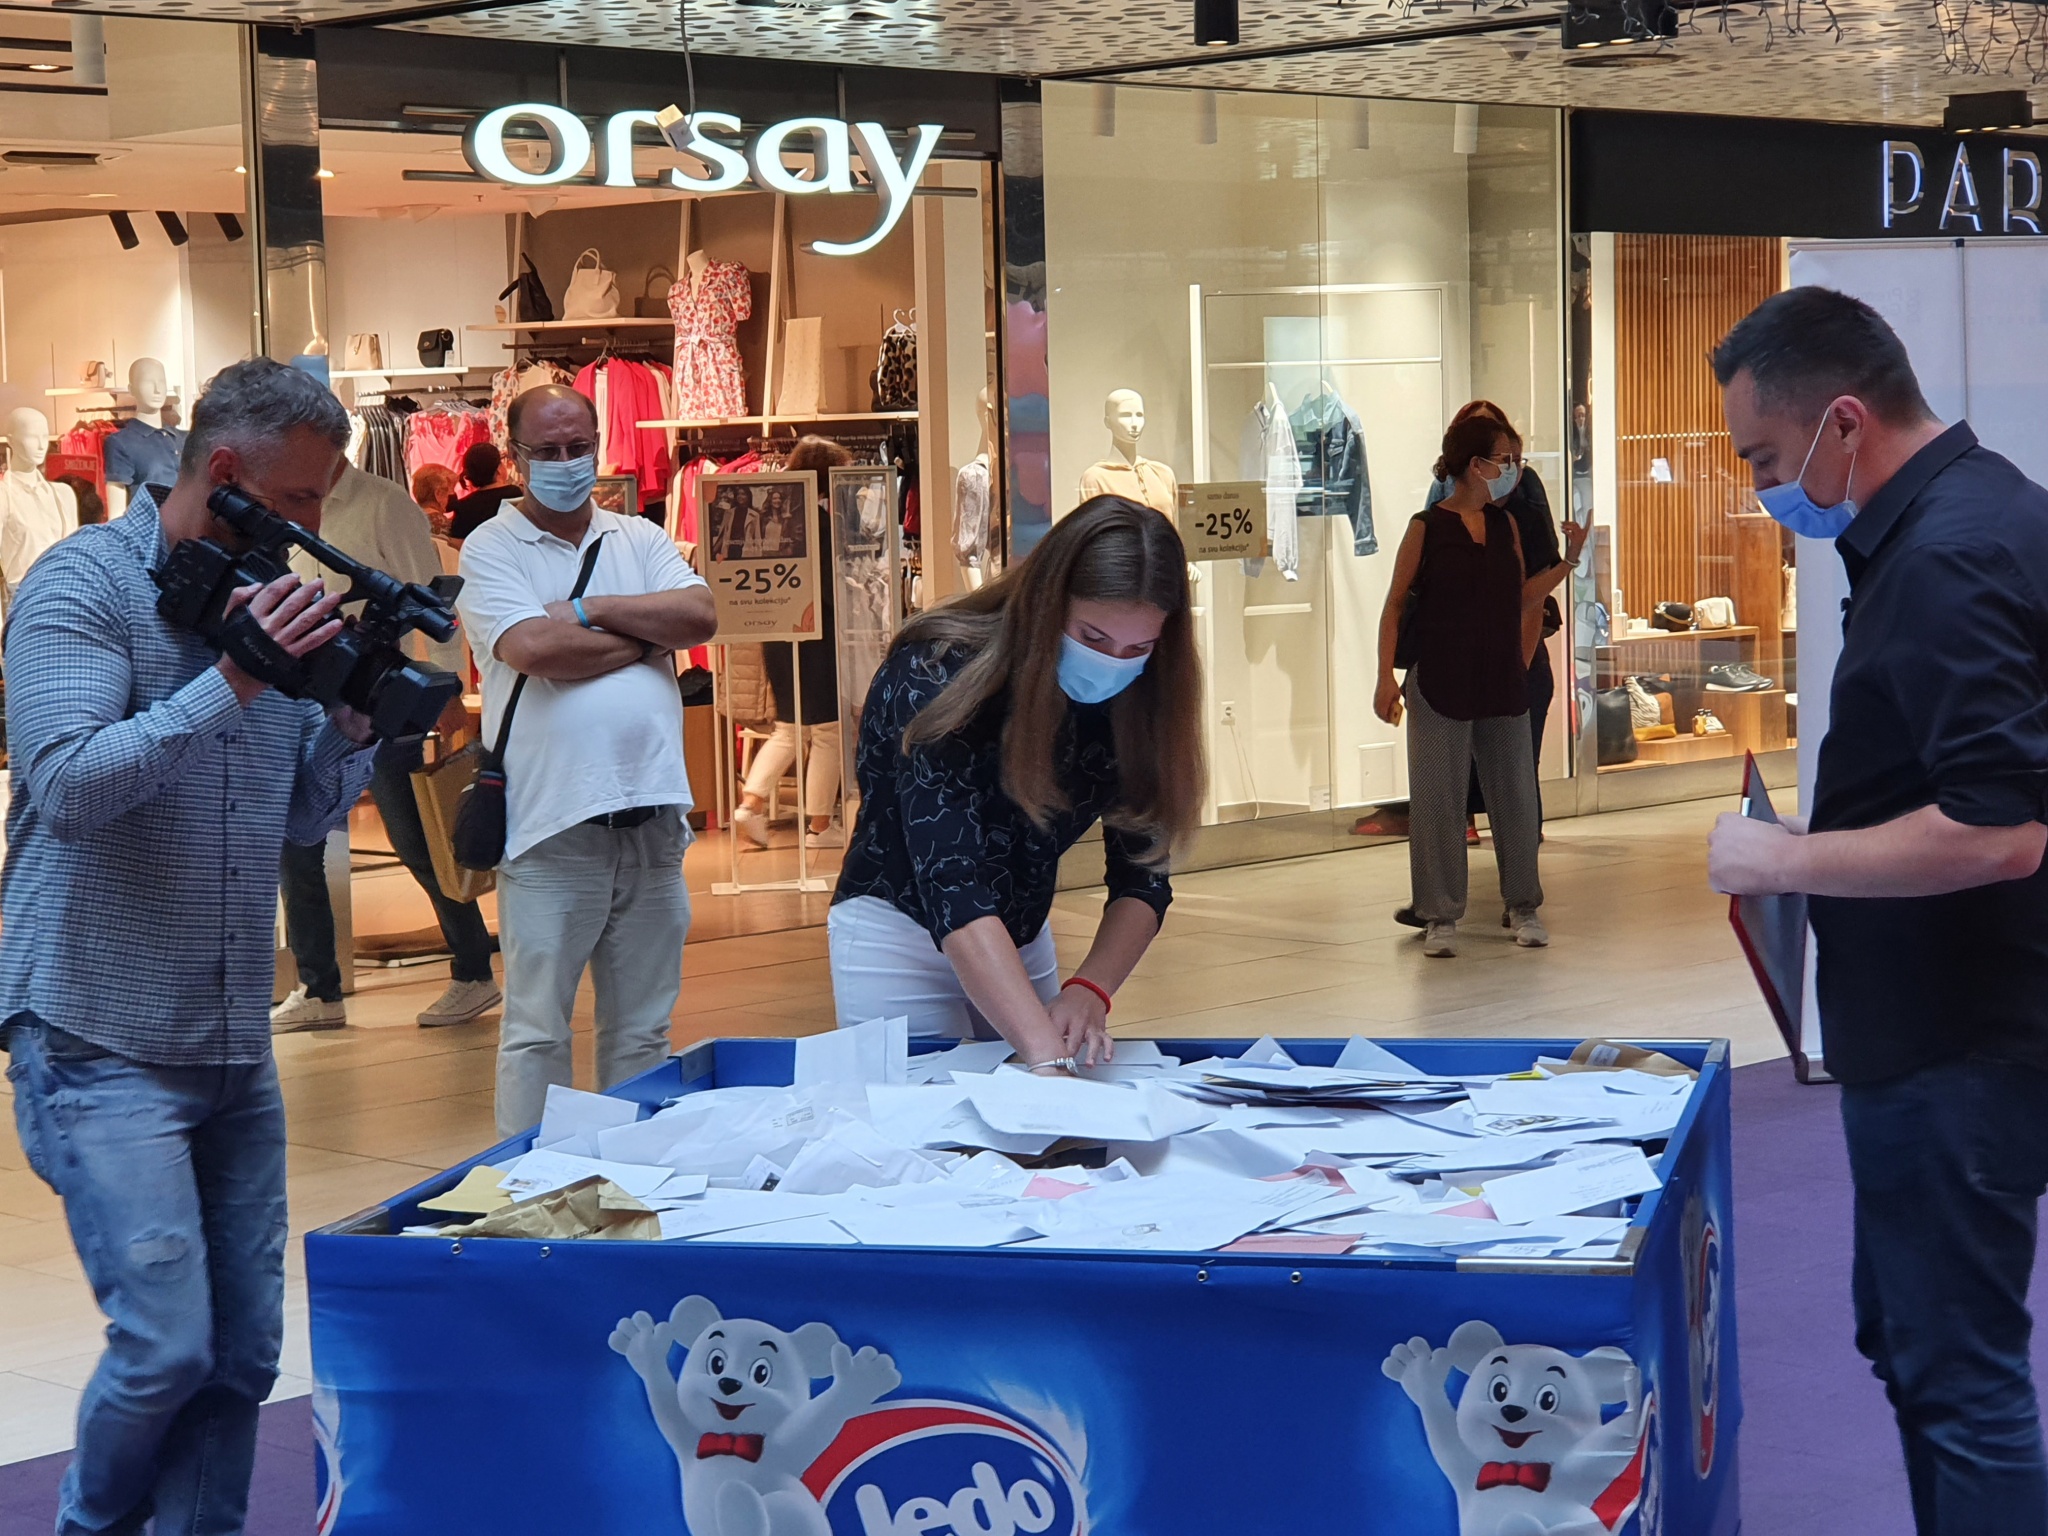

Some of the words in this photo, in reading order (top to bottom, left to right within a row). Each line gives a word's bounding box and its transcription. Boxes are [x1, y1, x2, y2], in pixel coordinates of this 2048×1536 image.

[468, 103, 944, 256] orsay
[1883, 140, 2043, 234] PAR
[1195, 507, 1253, 540] -25%
[719, 563, 802, 594] -25%
[744, 620, 778, 629] orsay
